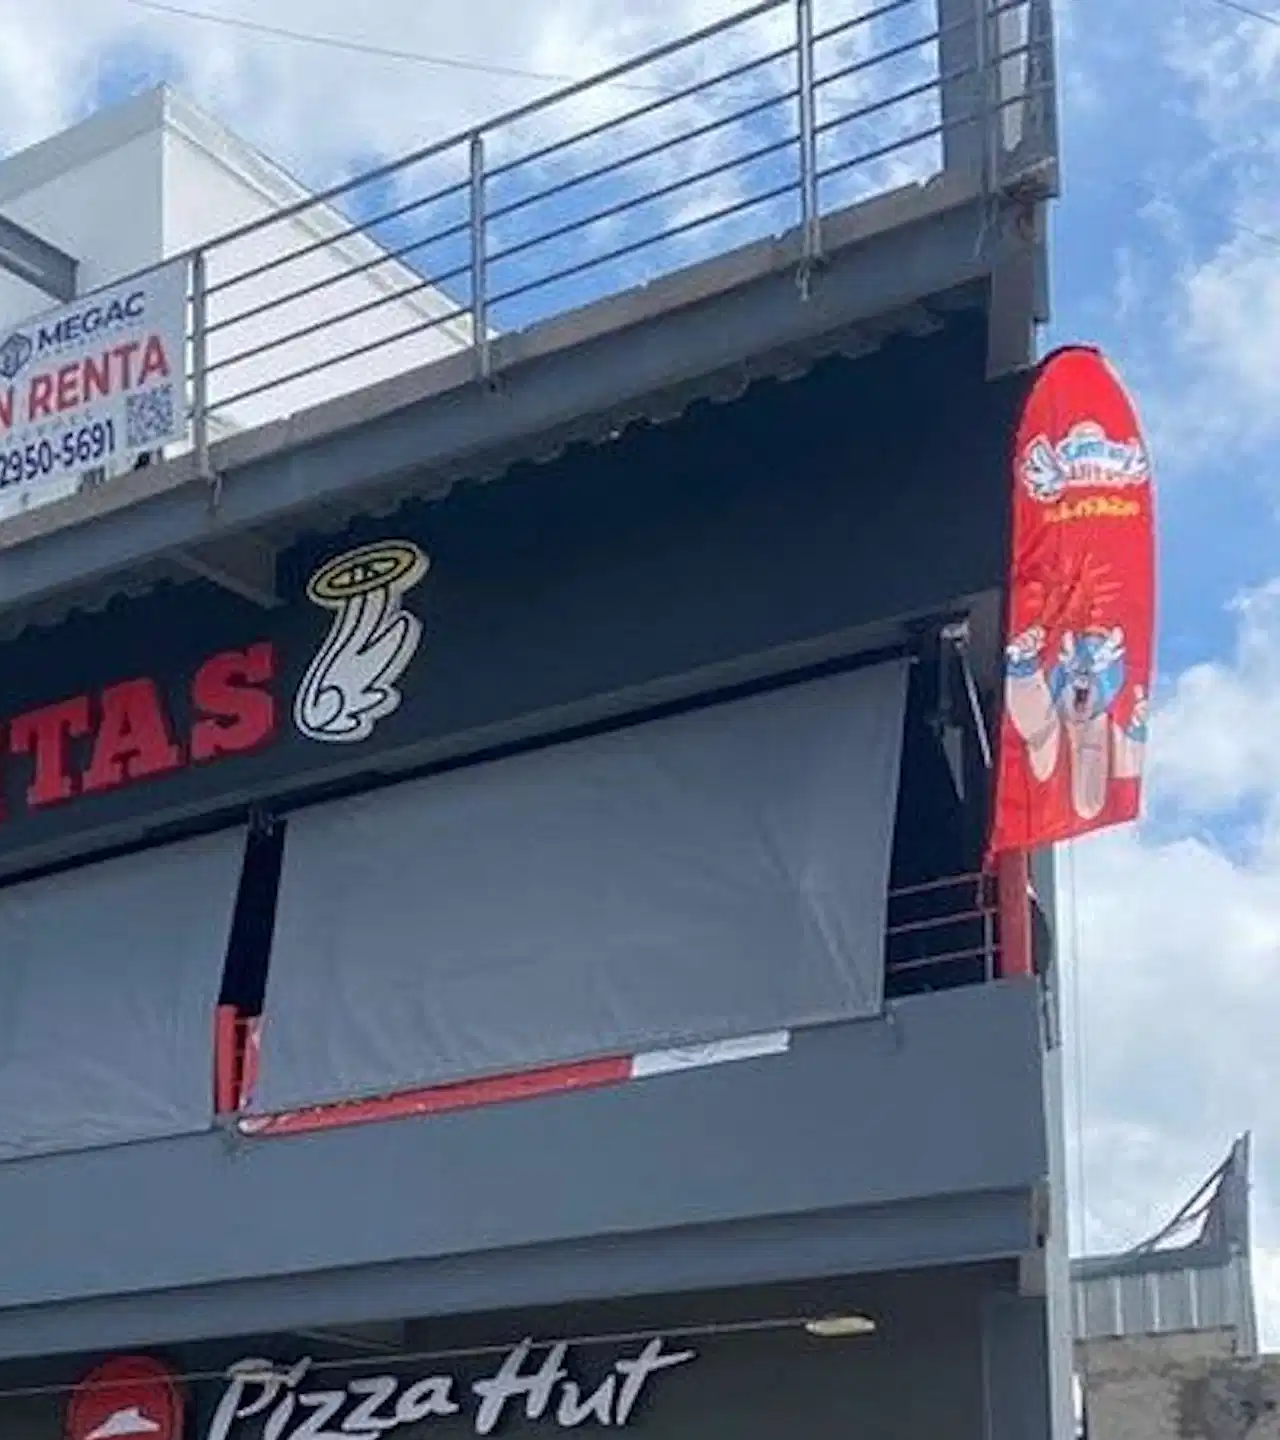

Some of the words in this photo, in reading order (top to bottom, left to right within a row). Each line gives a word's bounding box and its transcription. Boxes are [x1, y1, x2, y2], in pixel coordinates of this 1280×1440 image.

[38, 291, 144, 351] MEGAC
[28, 334, 170, 421] RENTA
[472, 1336, 696, 1435] Hut
